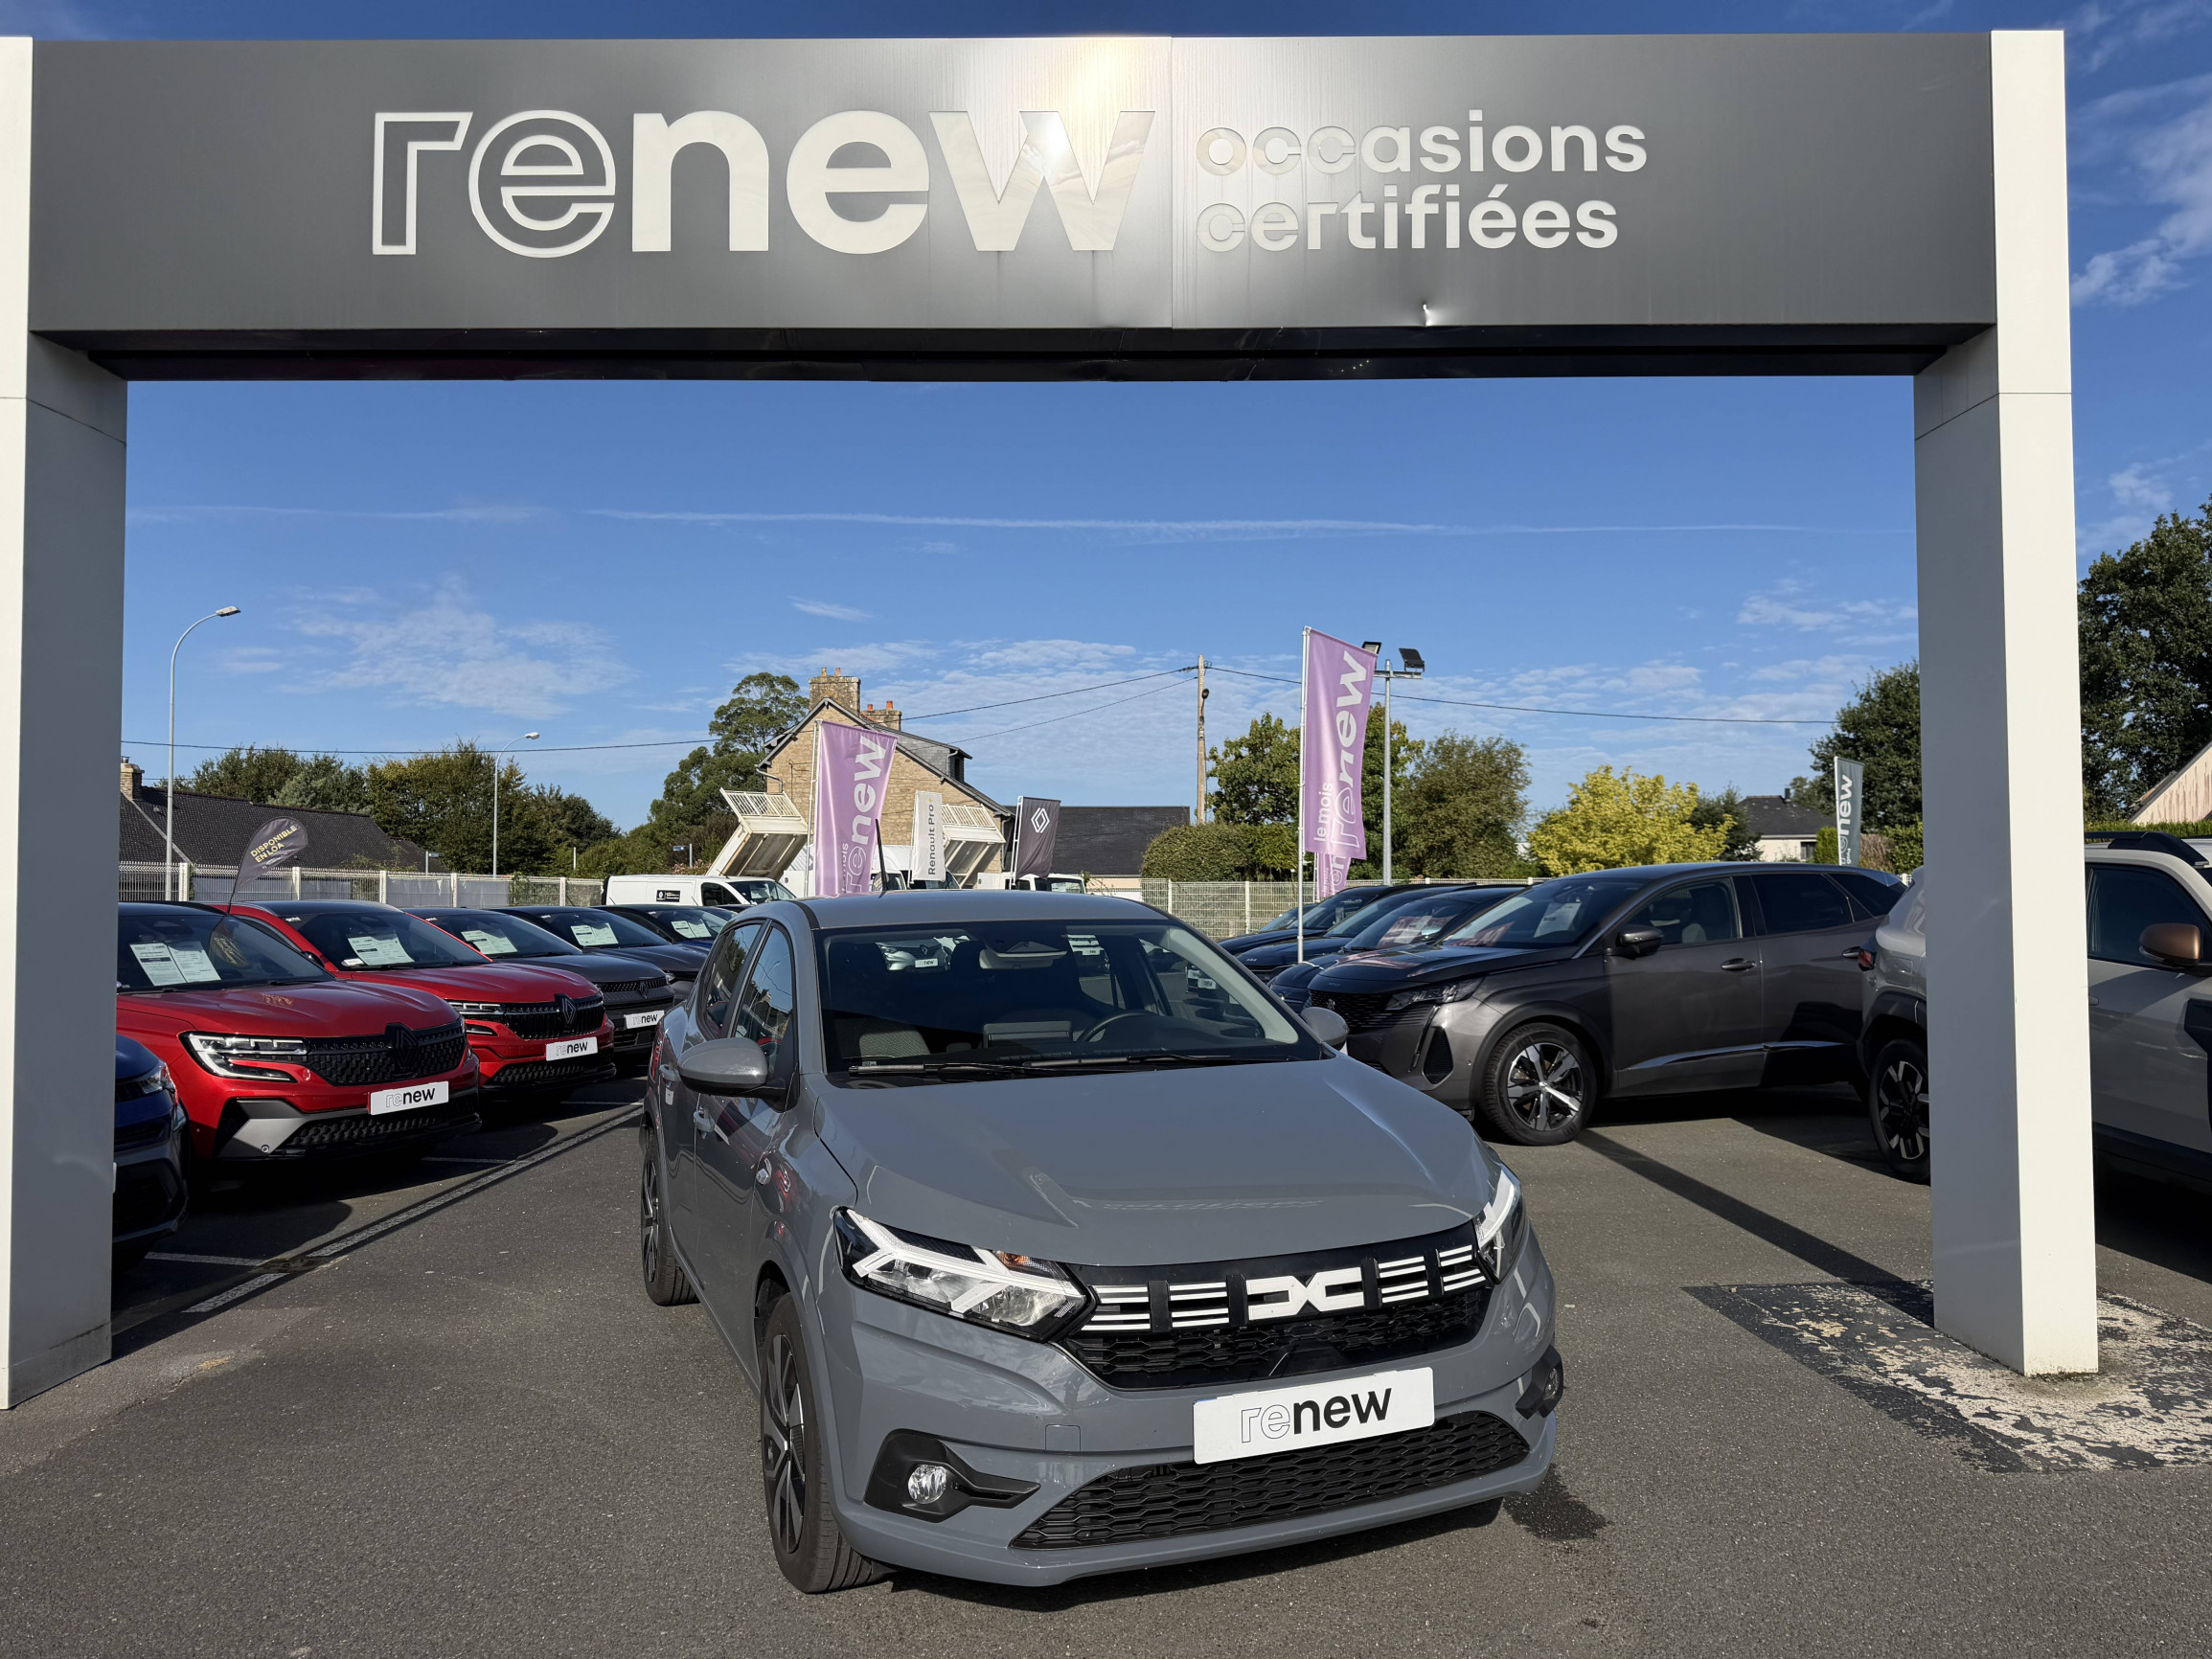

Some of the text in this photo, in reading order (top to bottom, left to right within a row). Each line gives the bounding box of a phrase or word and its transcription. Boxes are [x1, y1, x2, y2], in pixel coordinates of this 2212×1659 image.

[1196, 109, 1648, 175] occasions
[372, 109, 1155, 259] renew
[1196, 183, 1619, 253] certifiées
[1331, 650, 1367, 848] renew
[846, 736, 886, 893] renew
[1317, 782, 1333, 826] mois
[250, 825, 297, 857] DISPONIBLE
[255, 852, 268, 863] EN
[266, 842, 285, 856] LOA
[556, 1041, 588, 1057] renew
[386, 1088, 435, 1108] renew
[1241, 1387, 1392, 1443] renew
